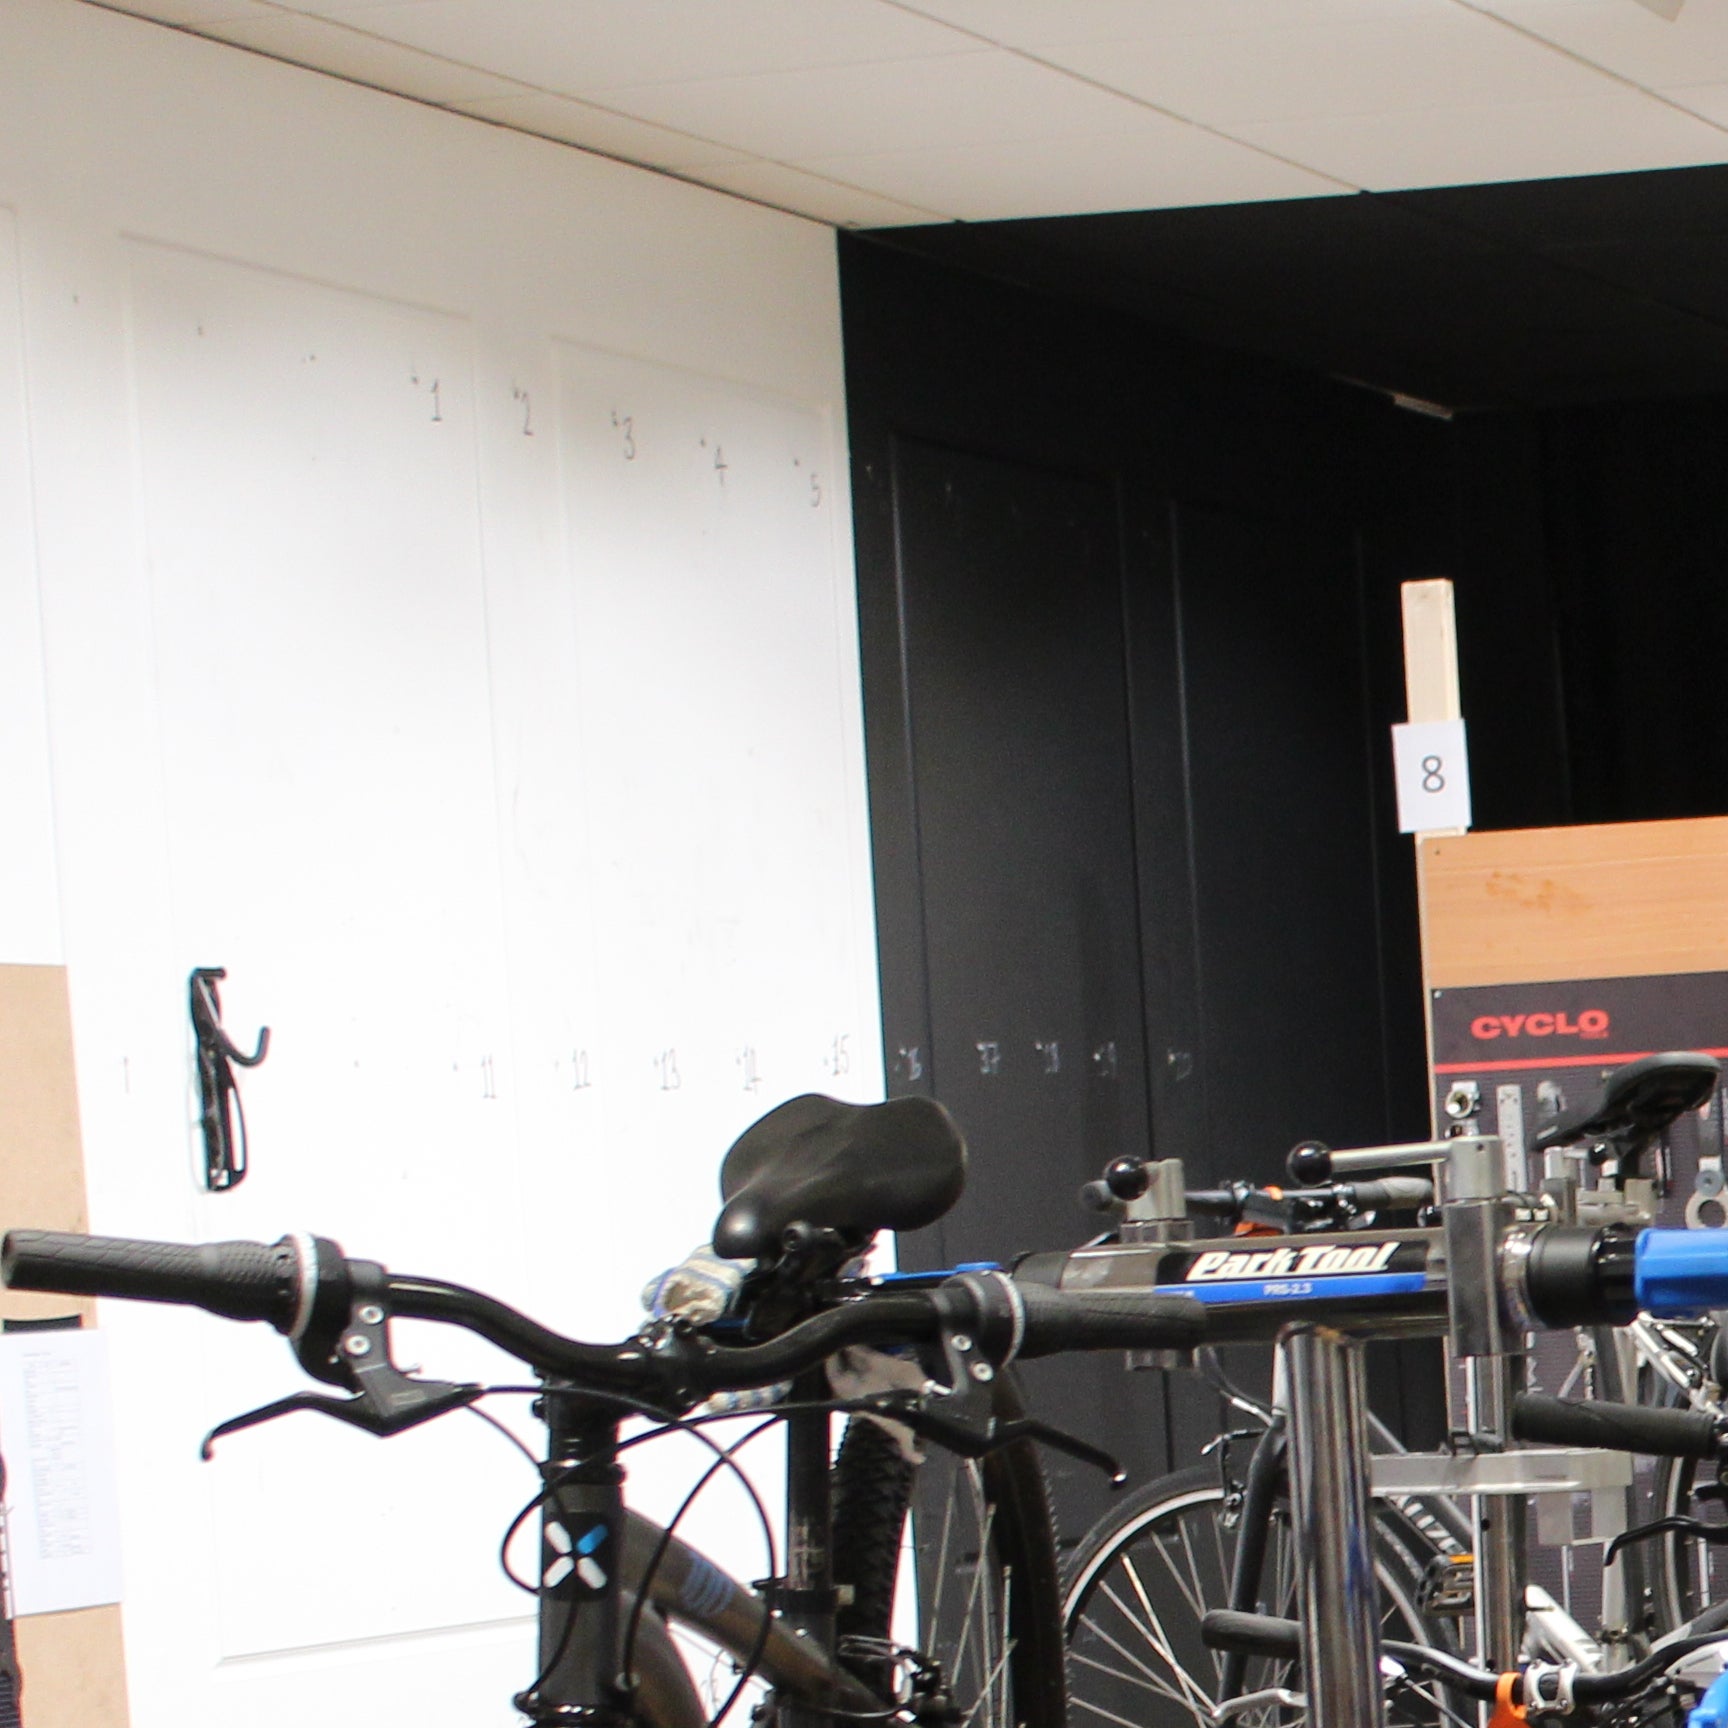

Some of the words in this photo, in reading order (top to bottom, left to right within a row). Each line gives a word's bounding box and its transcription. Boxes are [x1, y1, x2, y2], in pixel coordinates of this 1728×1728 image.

[1420, 754, 1446, 794] 8
[1470, 1009, 1610, 1039] CYCLO
[1186, 1247, 1297, 1282] Park
[1296, 1241, 1402, 1276] Tool
